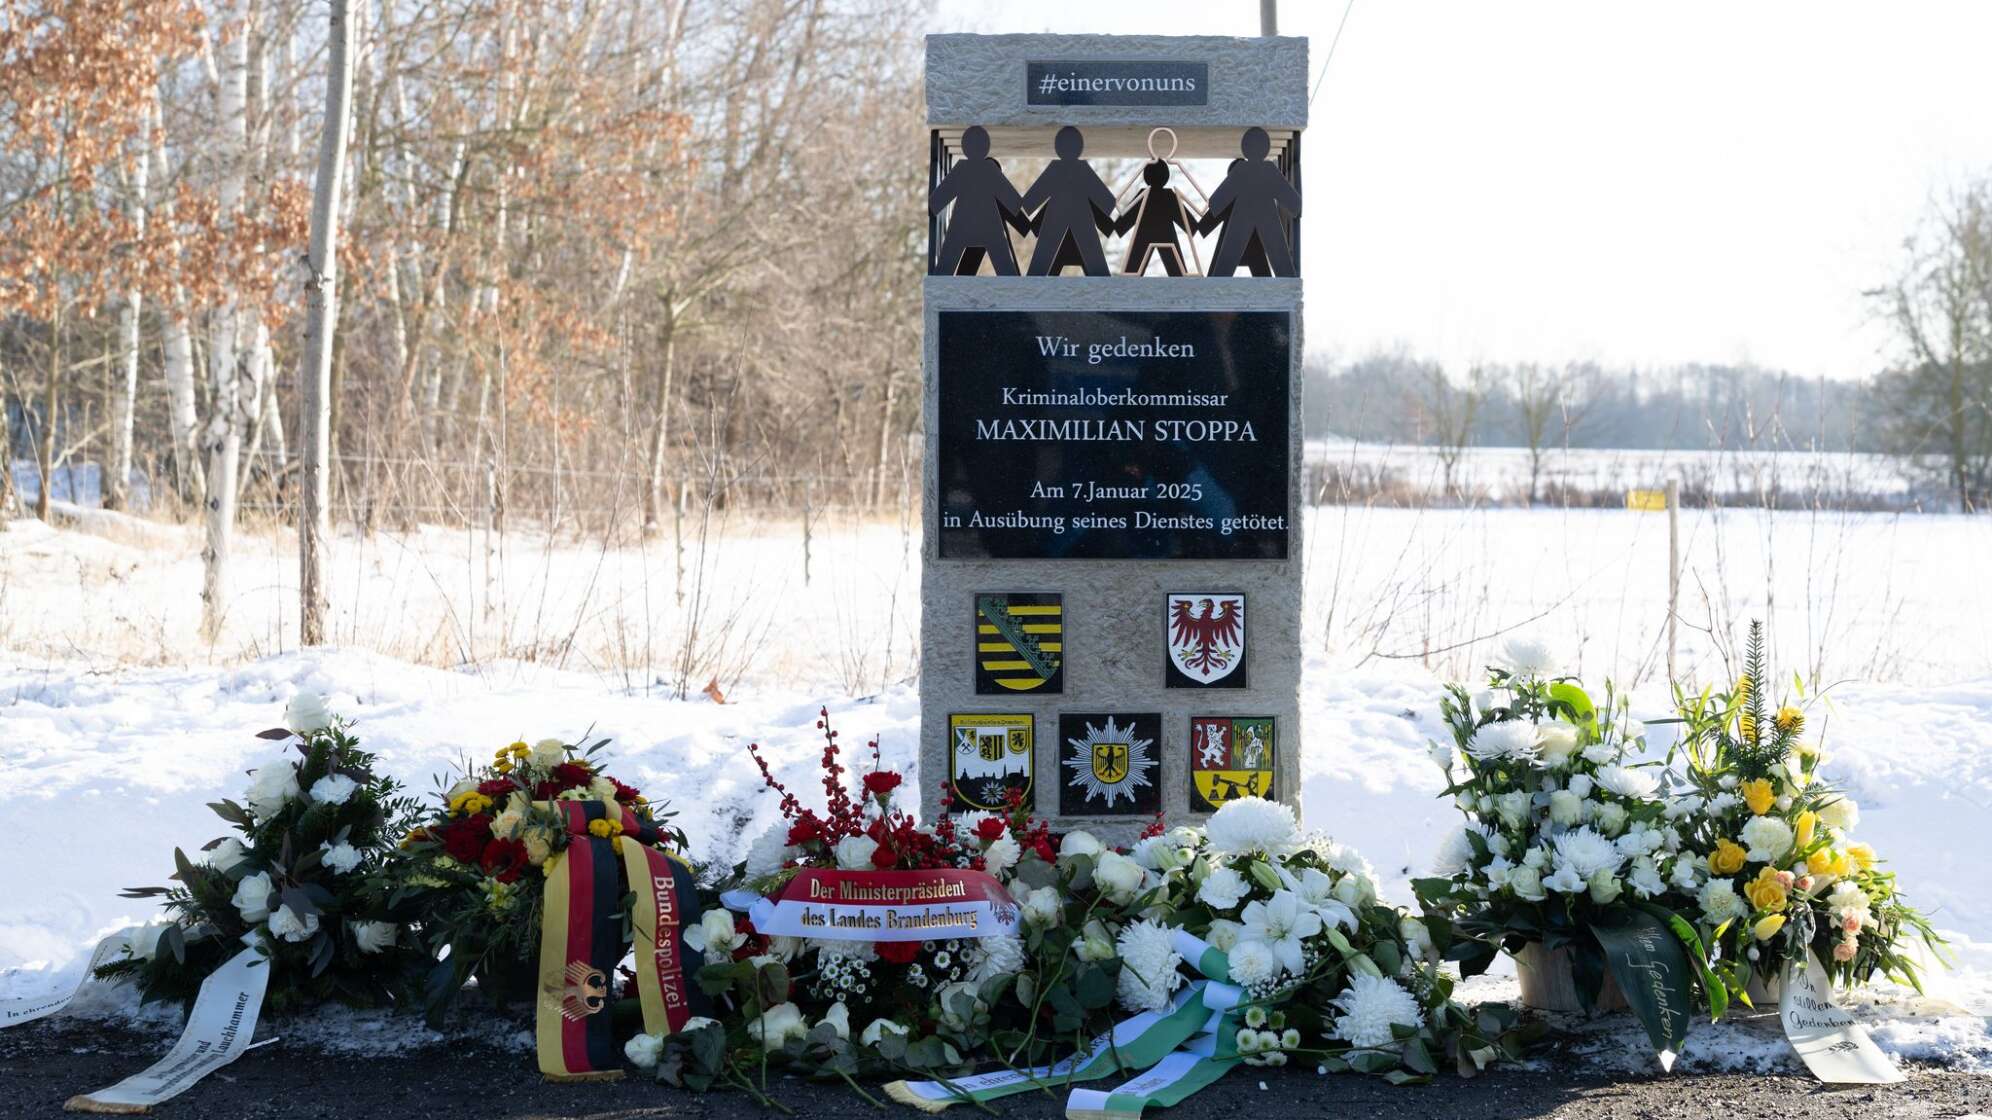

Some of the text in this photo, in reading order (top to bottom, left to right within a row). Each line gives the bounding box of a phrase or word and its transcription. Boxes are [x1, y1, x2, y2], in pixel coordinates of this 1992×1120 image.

[1038, 72, 1196, 95] #einervonuns
[1036, 336, 1195, 364] Wir gedenken
[1002, 387, 1229, 407] Kriminaloberkommissar
[976, 419, 1258, 442] MAXIMILIAN STOPPA
[1029, 482, 1064, 499] Am
[1156, 483, 1203, 501] 2025
[943, 511, 1289, 535] in Ausübung seines Dienstes getötet.
[810, 878, 966, 904] Der Ministerpräsident
[802, 906, 978, 929] des Landes Brandenburg
[654, 876, 688, 1008] Bundespolizei
